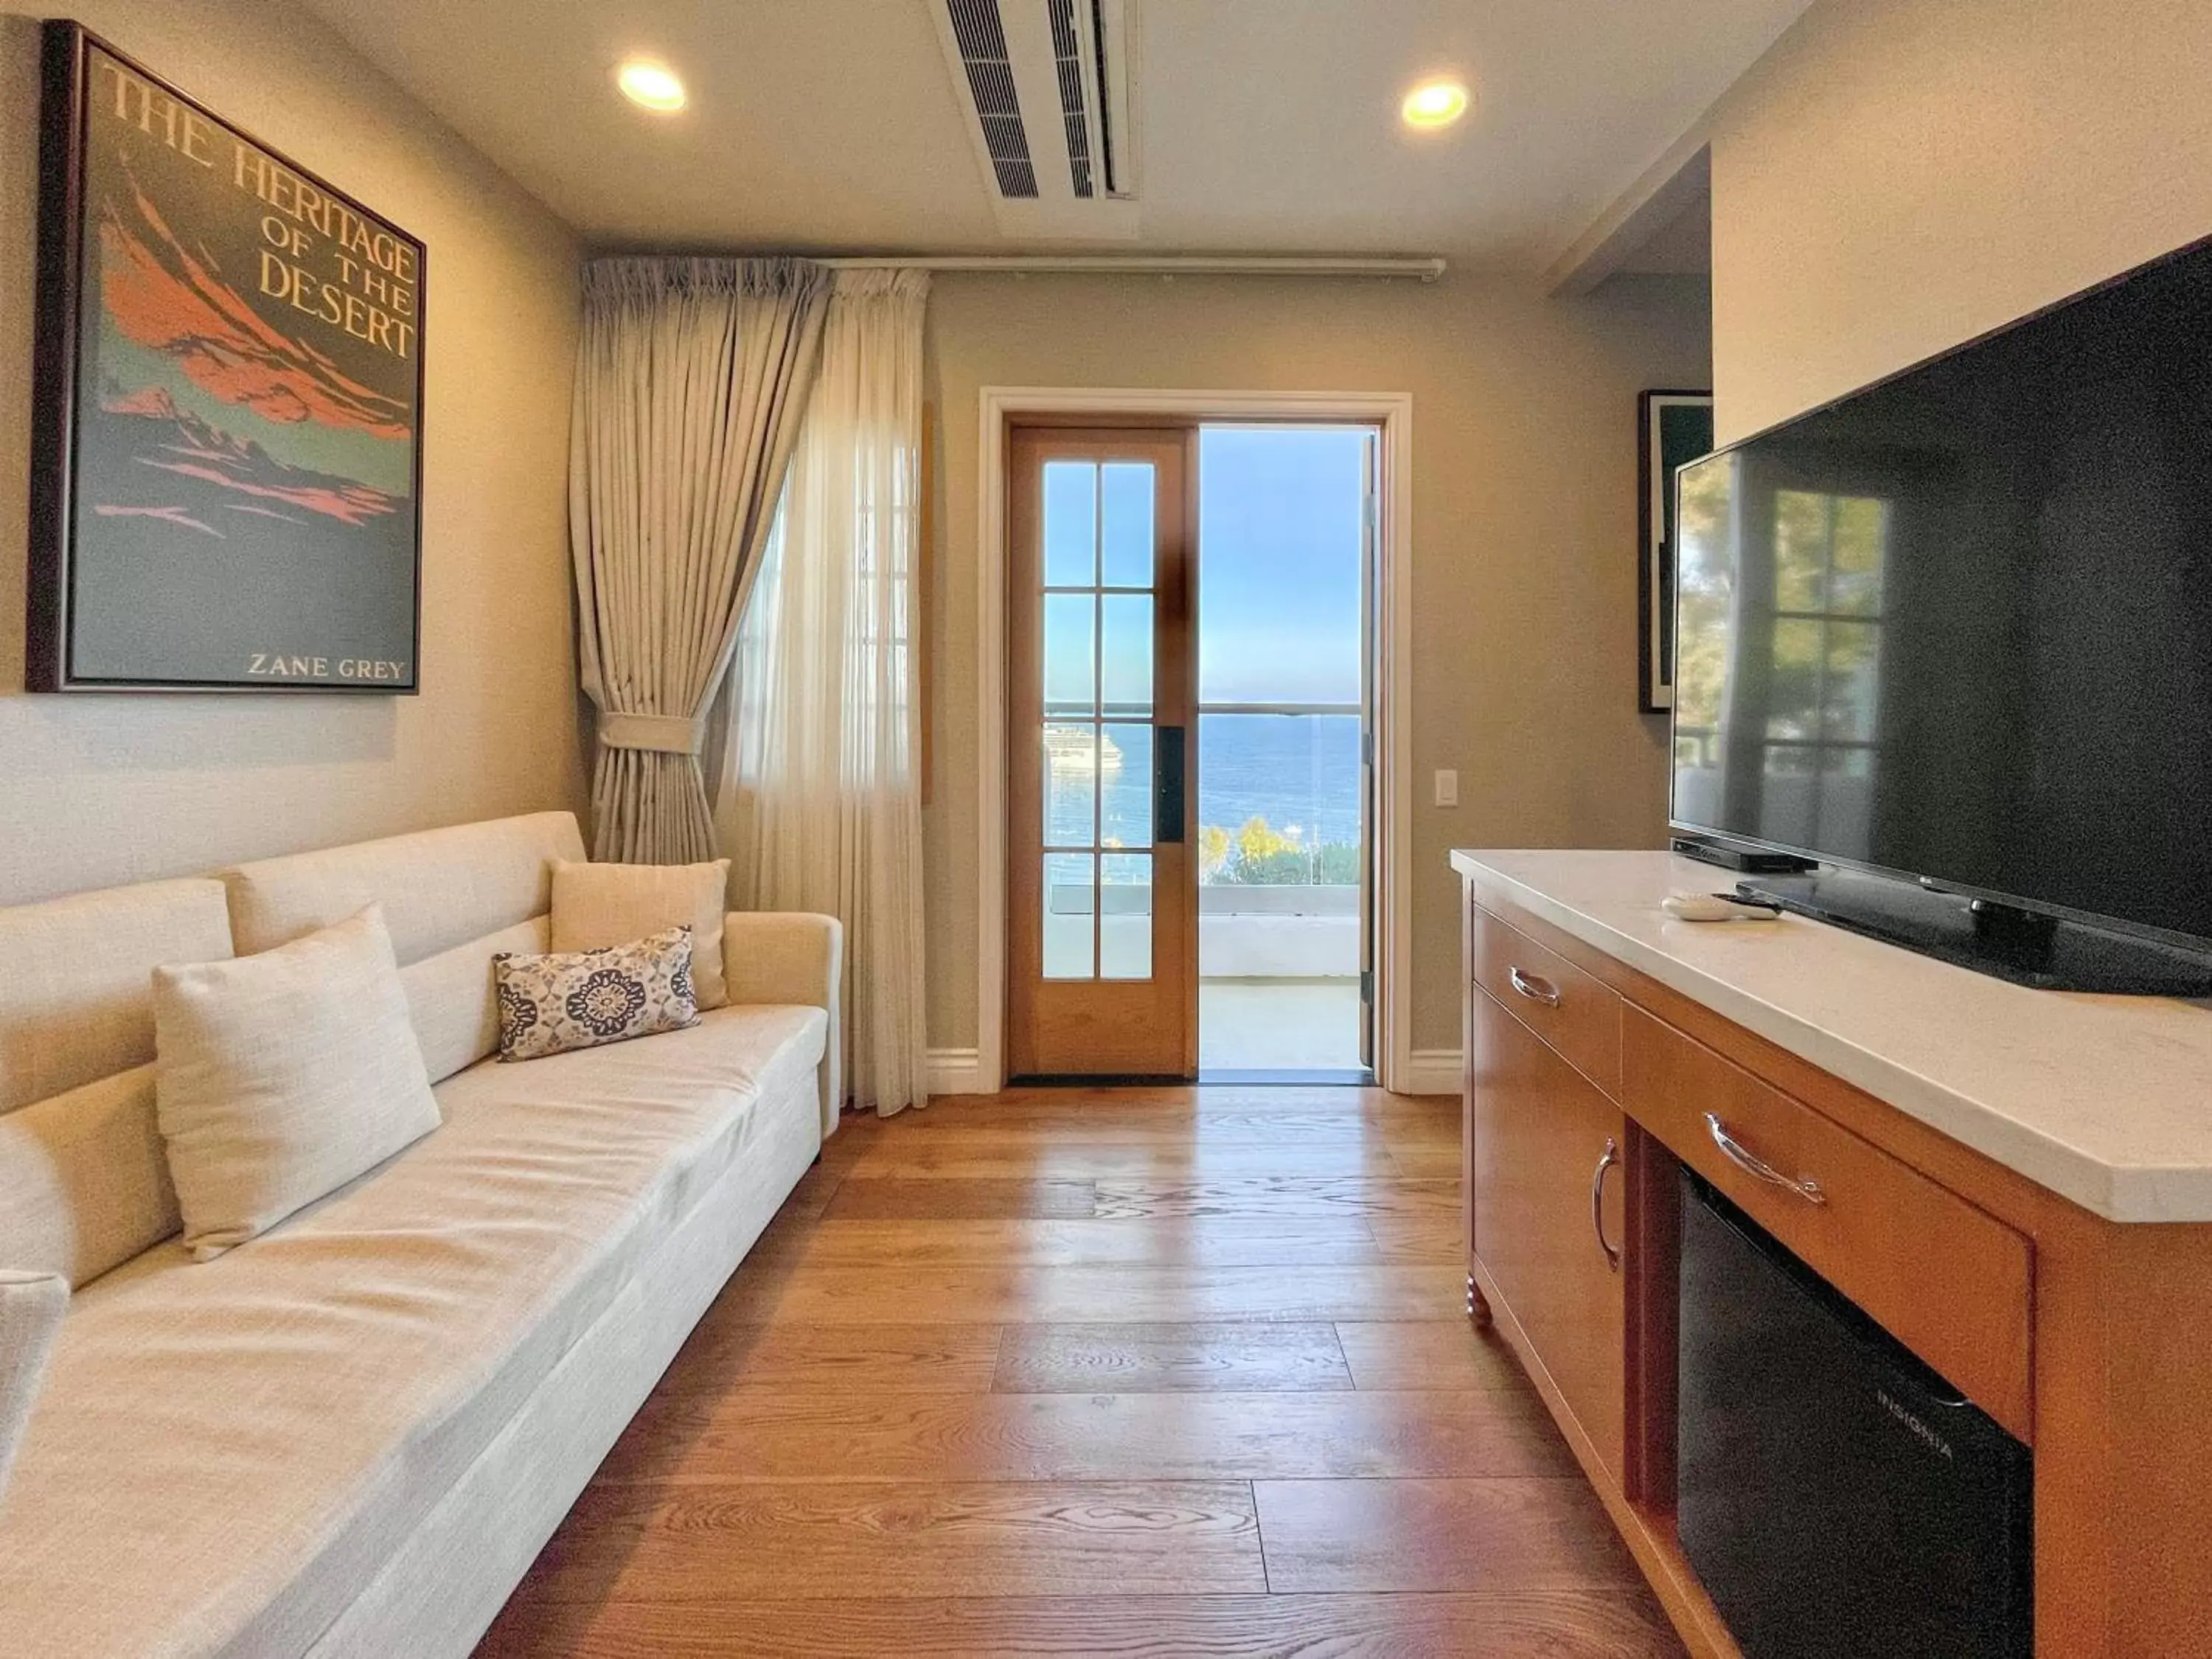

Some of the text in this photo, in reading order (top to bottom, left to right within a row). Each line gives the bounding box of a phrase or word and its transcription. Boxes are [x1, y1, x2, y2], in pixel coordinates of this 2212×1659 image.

[102, 63, 415, 285] THE HERITAGE
[259, 250, 414, 359] DESERT
[260, 215, 414, 317] OF THE
[247, 653, 406, 680] ZANE GREY
